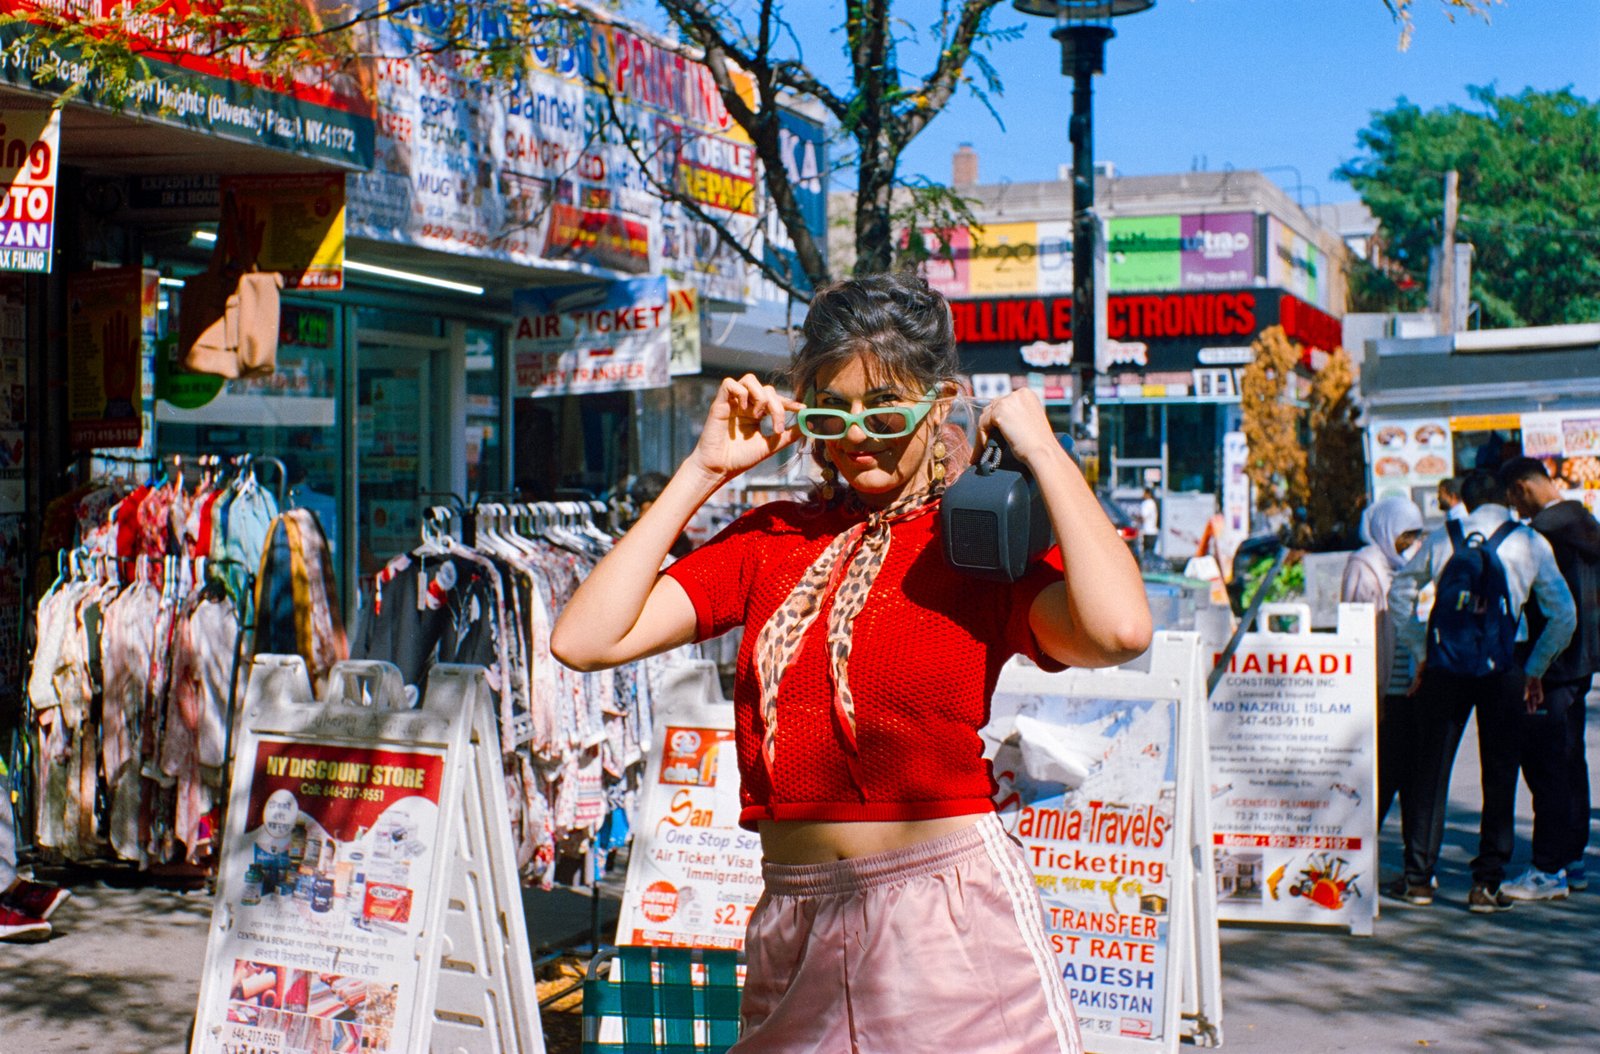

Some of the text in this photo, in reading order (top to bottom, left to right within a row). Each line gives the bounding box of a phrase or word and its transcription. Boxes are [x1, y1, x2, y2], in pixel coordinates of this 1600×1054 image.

[504, 130, 569, 168] CANOPY
[418, 173, 450, 197] MUG
[12, 252, 44, 271] FILING
[516, 306, 664, 340] AIR TICKET
[951, 300, 1050, 343] OLLIKA
[1053, 292, 1257, 340] ECTRONICS
[573, 363, 645, 383] TRANSFER
[1226, 677, 1314, 688] CONSTRUCTION
[1212, 701, 1352, 714] MD NAZRUL ISLAM
[266, 755, 426, 789] NY DISCOUNT STORE
[323, 785, 385, 802] 646-217-9551
[655, 788, 715, 838] San
[1089, 801, 1166, 849] Travels
[1286, 812, 1313, 823] Road
[665, 829, 694, 845] One
[697, 831, 731, 850] Stop
[677, 849, 716, 866] Ticket
[1029, 845, 1165, 884] Ticketing
[1049, 908, 1158, 939] TRANSFER
[1090, 939, 1156, 964] RATE
[1069, 988, 1153, 1014] PAKISTAN
[231, 1026, 282, 1047] 646-217-9551
